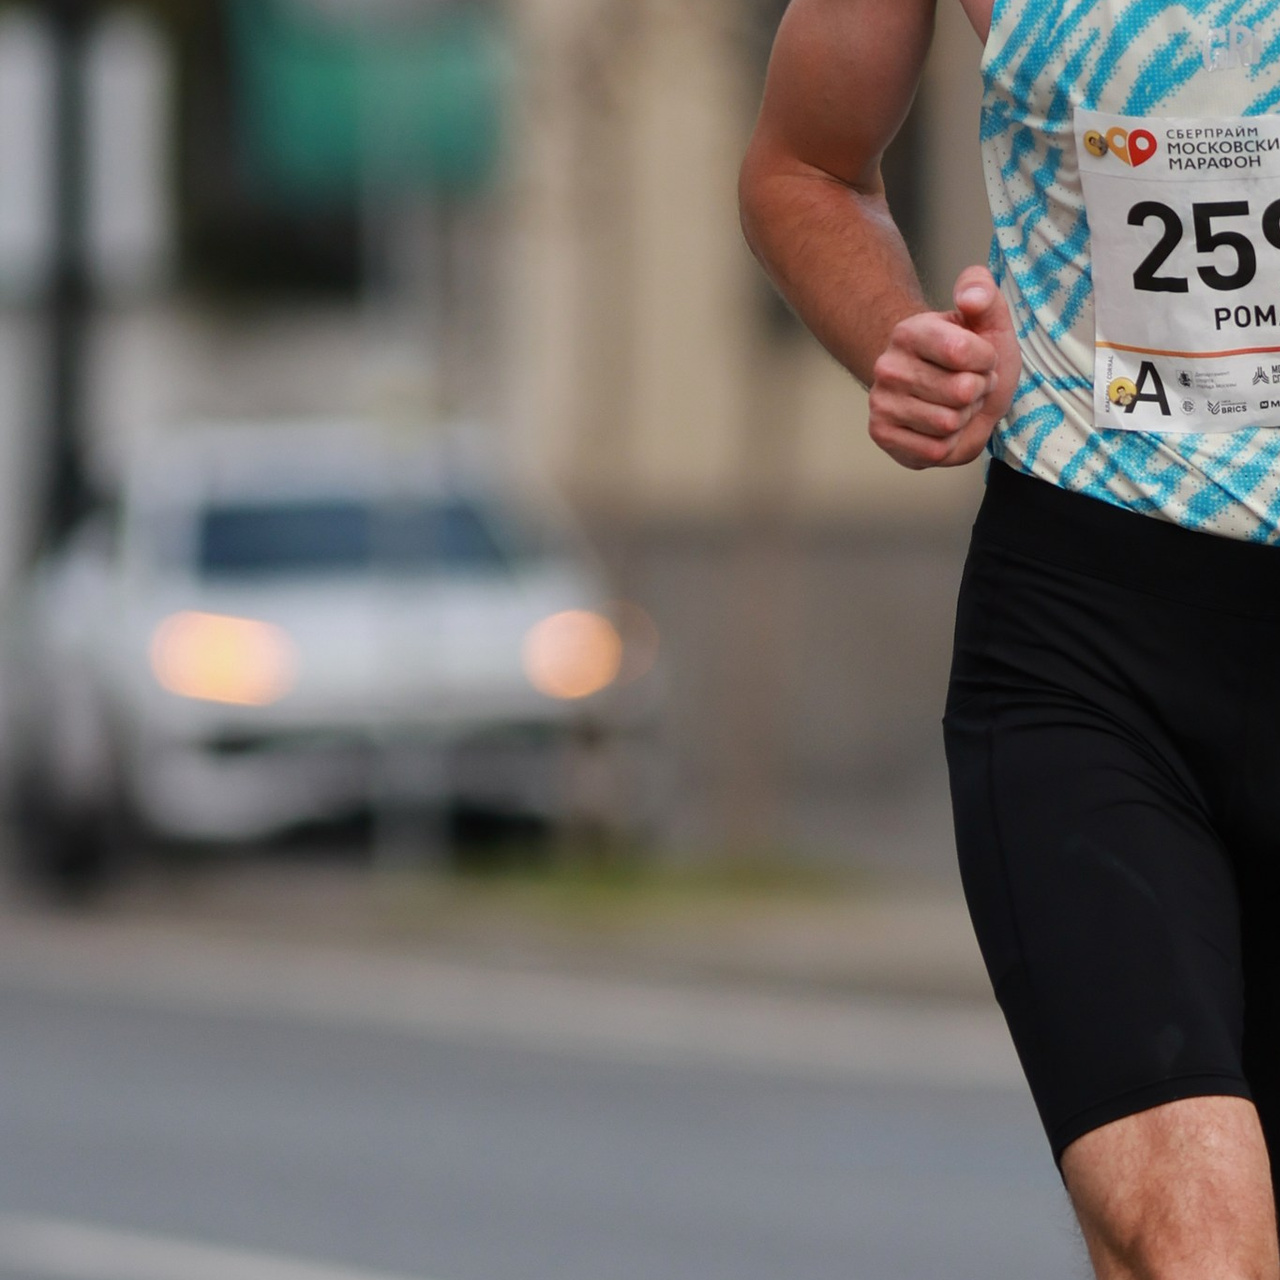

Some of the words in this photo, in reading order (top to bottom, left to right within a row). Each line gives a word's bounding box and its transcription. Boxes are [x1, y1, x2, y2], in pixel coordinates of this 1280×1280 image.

[1166, 125, 1258, 139] СБЕРПРАЙМ
[1169, 155, 1261, 170] МАРАФОН
[1124, 360, 1172, 416] A
[1221, 405, 1247, 414] BRICS
